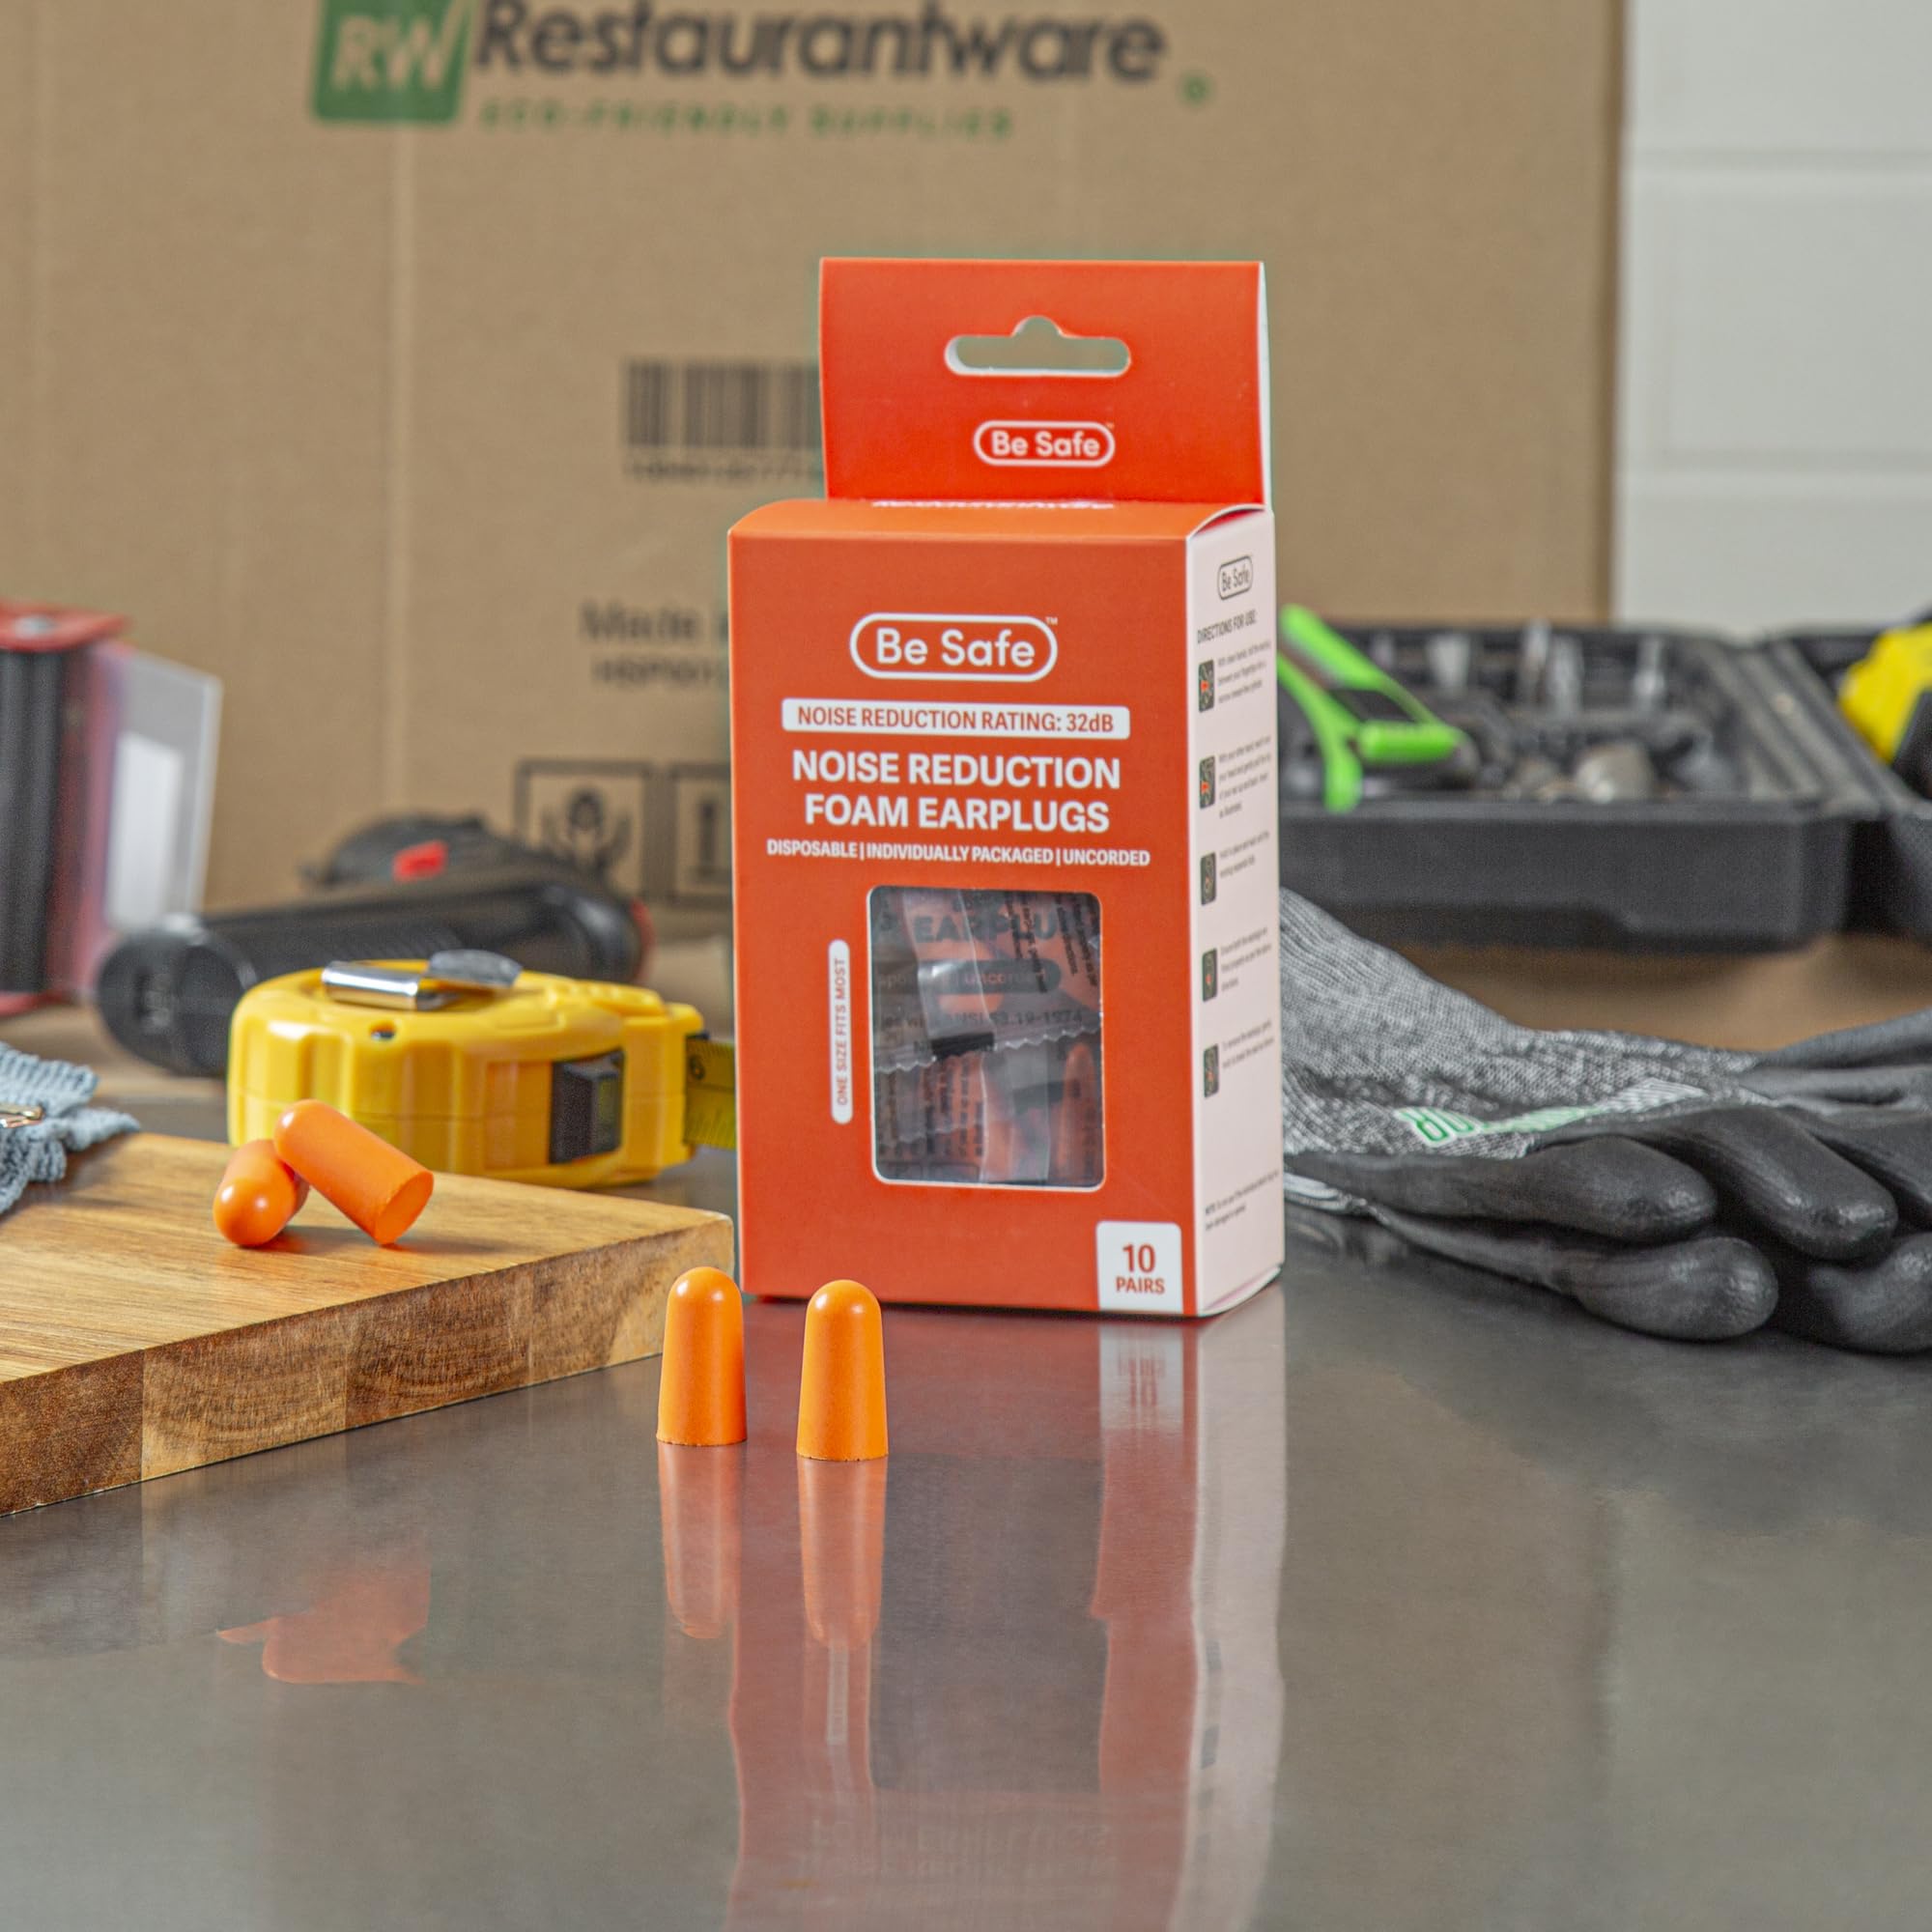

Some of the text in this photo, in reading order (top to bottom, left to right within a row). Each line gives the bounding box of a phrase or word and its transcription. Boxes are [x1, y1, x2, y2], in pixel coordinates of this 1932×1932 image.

[332, 4, 473, 91] RW
[480, 0, 1169, 80] Restaurantware
[992, 430, 1100, 457] Be Safe
[876, 628, 928, 666] Be
[941, 628, 1036, 668] Safe
[797, 706, 1114, 733] NOISE REDUCTION RATING: 32dB
[792, 751, 1122, 789] NOISE REDUCTION
[805, 794, 1110, 834] FOAM EARPLUGS
[767, 838, 1151, 867] DISPOSABLE INDIVIDUALLY PACKAGED UNCORDED
[833, 957, 848, 1106] ONE SIZE FITS MOST
[1122, 1243, 1155, 1273] 10
[1116, 1276, 1165, 1295] PAIRS
